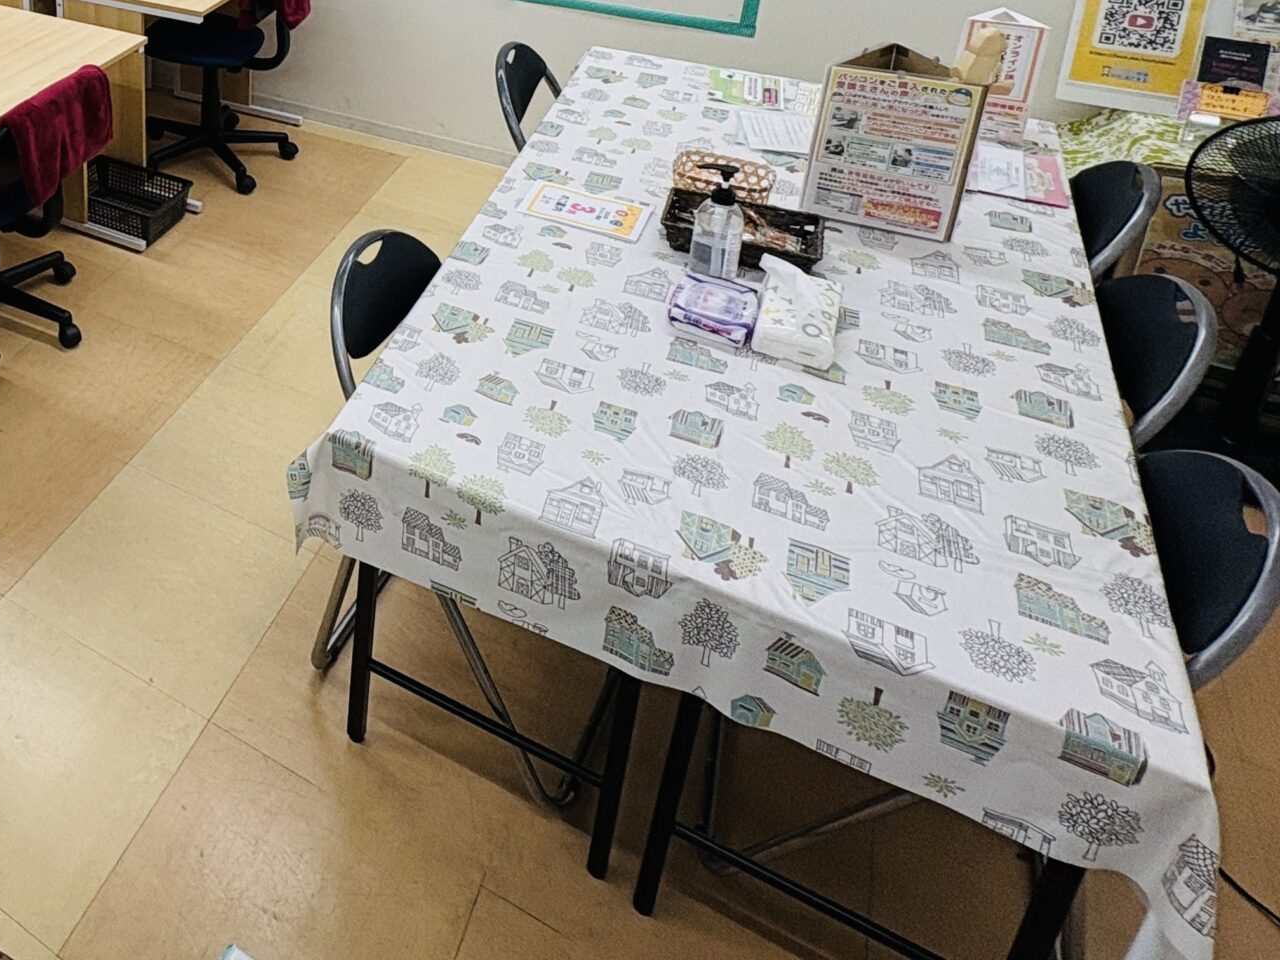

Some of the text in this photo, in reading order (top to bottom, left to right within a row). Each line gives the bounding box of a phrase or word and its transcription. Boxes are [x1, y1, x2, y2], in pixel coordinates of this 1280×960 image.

[1004, 33, 1024, 81] オンライン講
